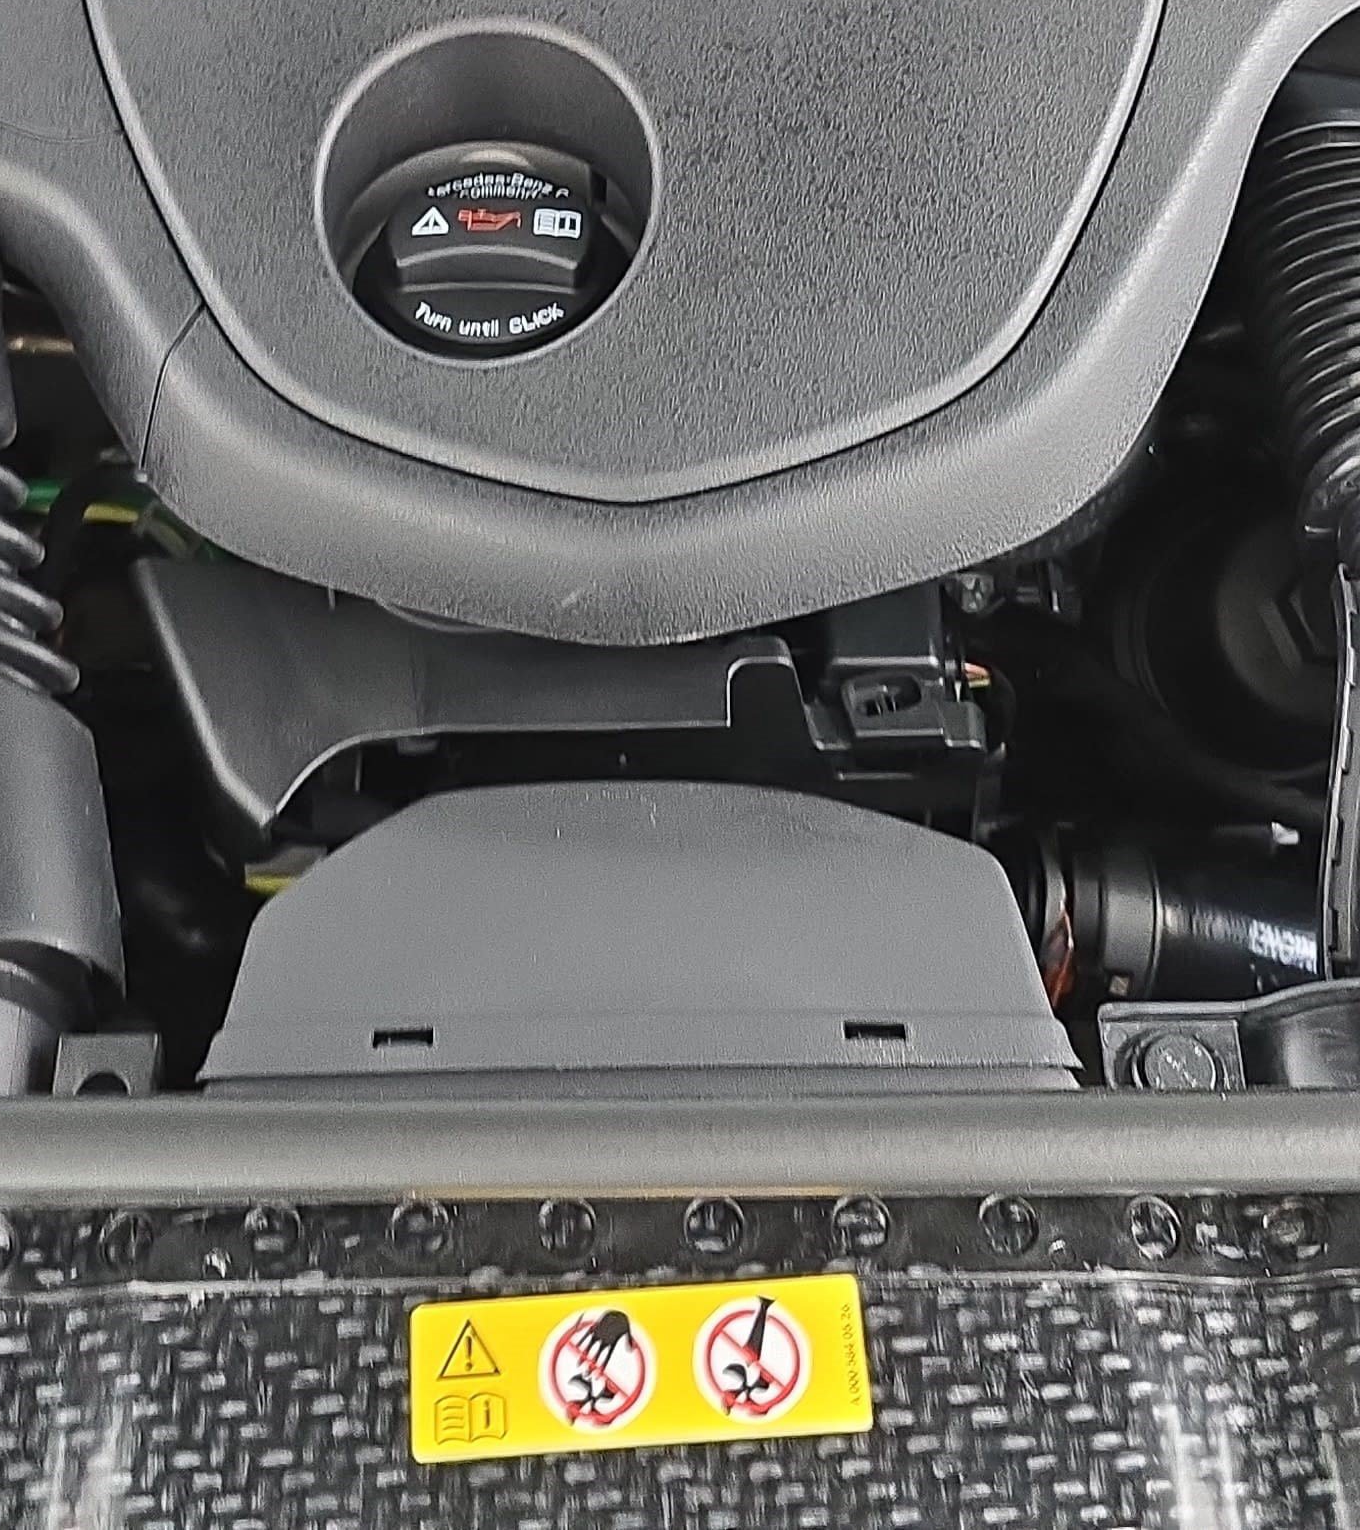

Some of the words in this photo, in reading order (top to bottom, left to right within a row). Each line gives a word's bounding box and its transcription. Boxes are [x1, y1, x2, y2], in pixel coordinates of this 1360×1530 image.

[415, 301, 452, 334] Turn
[459, 319, 500, 337] until
[509, 302, 564, 335] CLICK
